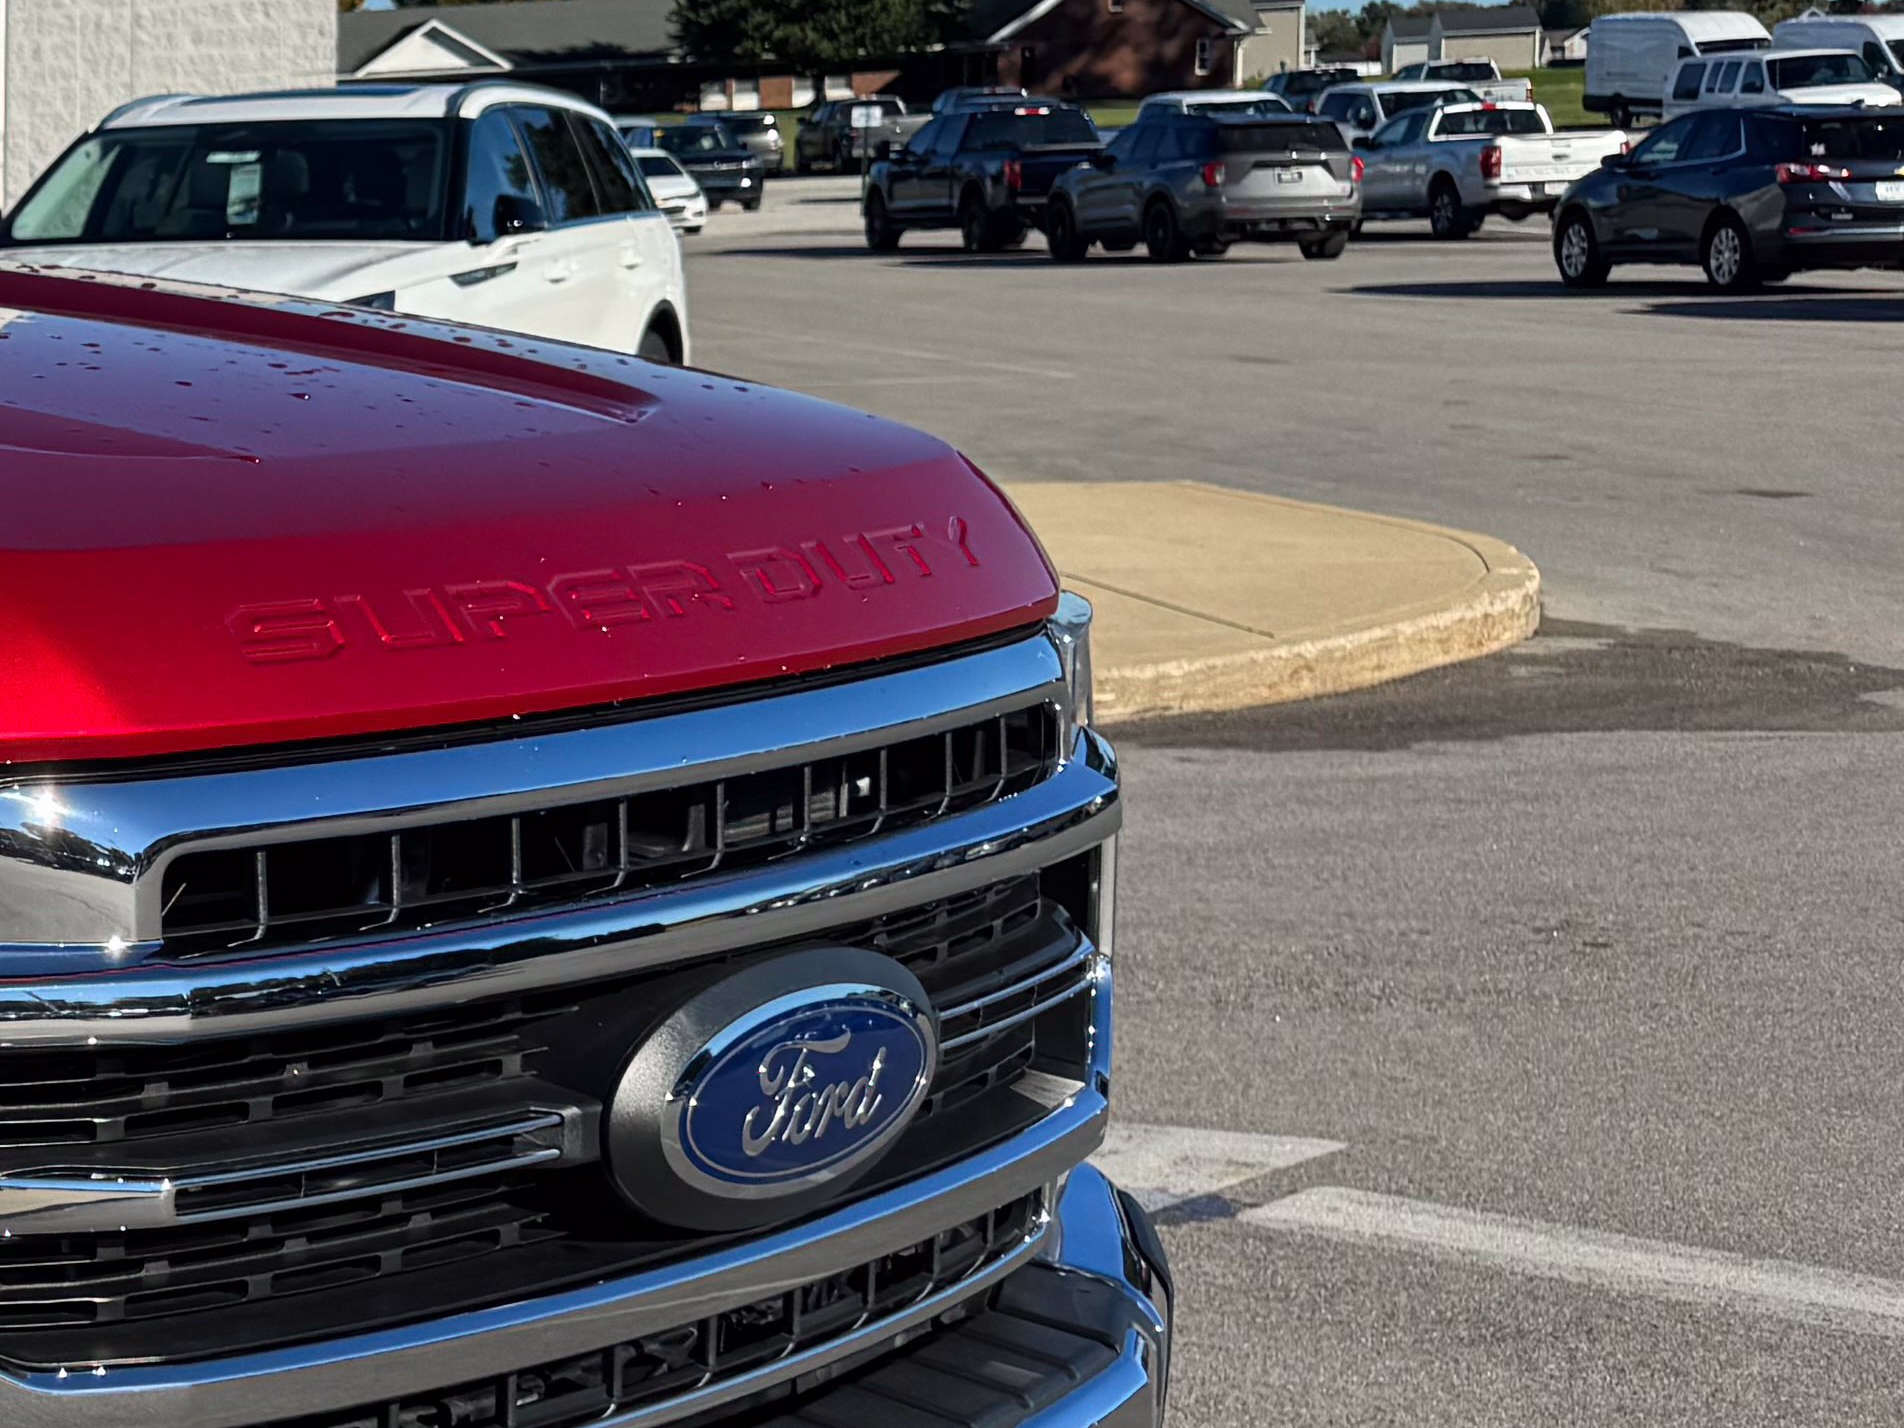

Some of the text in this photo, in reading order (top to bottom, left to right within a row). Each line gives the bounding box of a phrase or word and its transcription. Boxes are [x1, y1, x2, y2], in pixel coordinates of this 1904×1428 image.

[226, 516, 980, 663] SUPER DUTY
[742, 1027, 887, 1157] Ford
